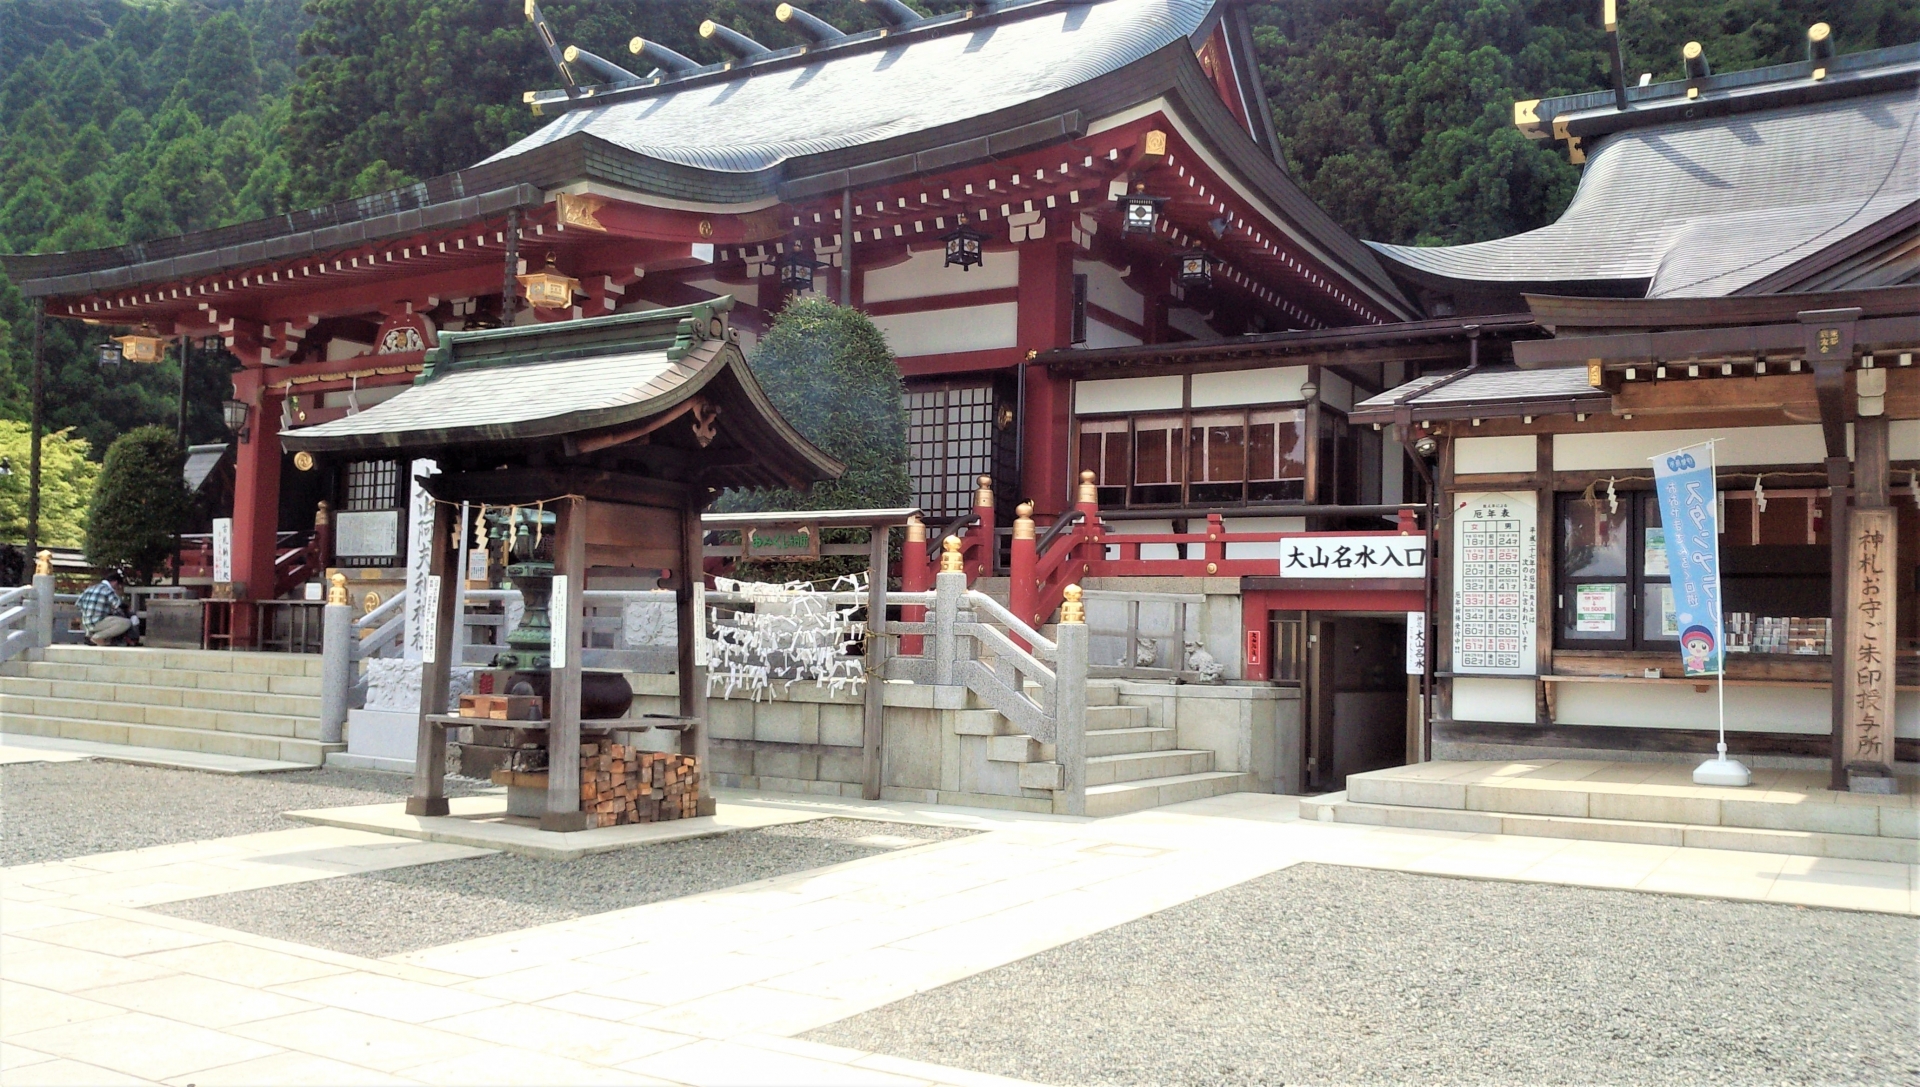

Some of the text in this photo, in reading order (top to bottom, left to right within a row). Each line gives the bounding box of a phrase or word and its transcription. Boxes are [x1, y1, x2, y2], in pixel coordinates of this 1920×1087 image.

[1473, 508, 1511, 518] 厄年表
[1285, 545, 1425, 569] 大山名水入口
[1856, 530, 1884, 756] 神札お守ご朱印授与所
